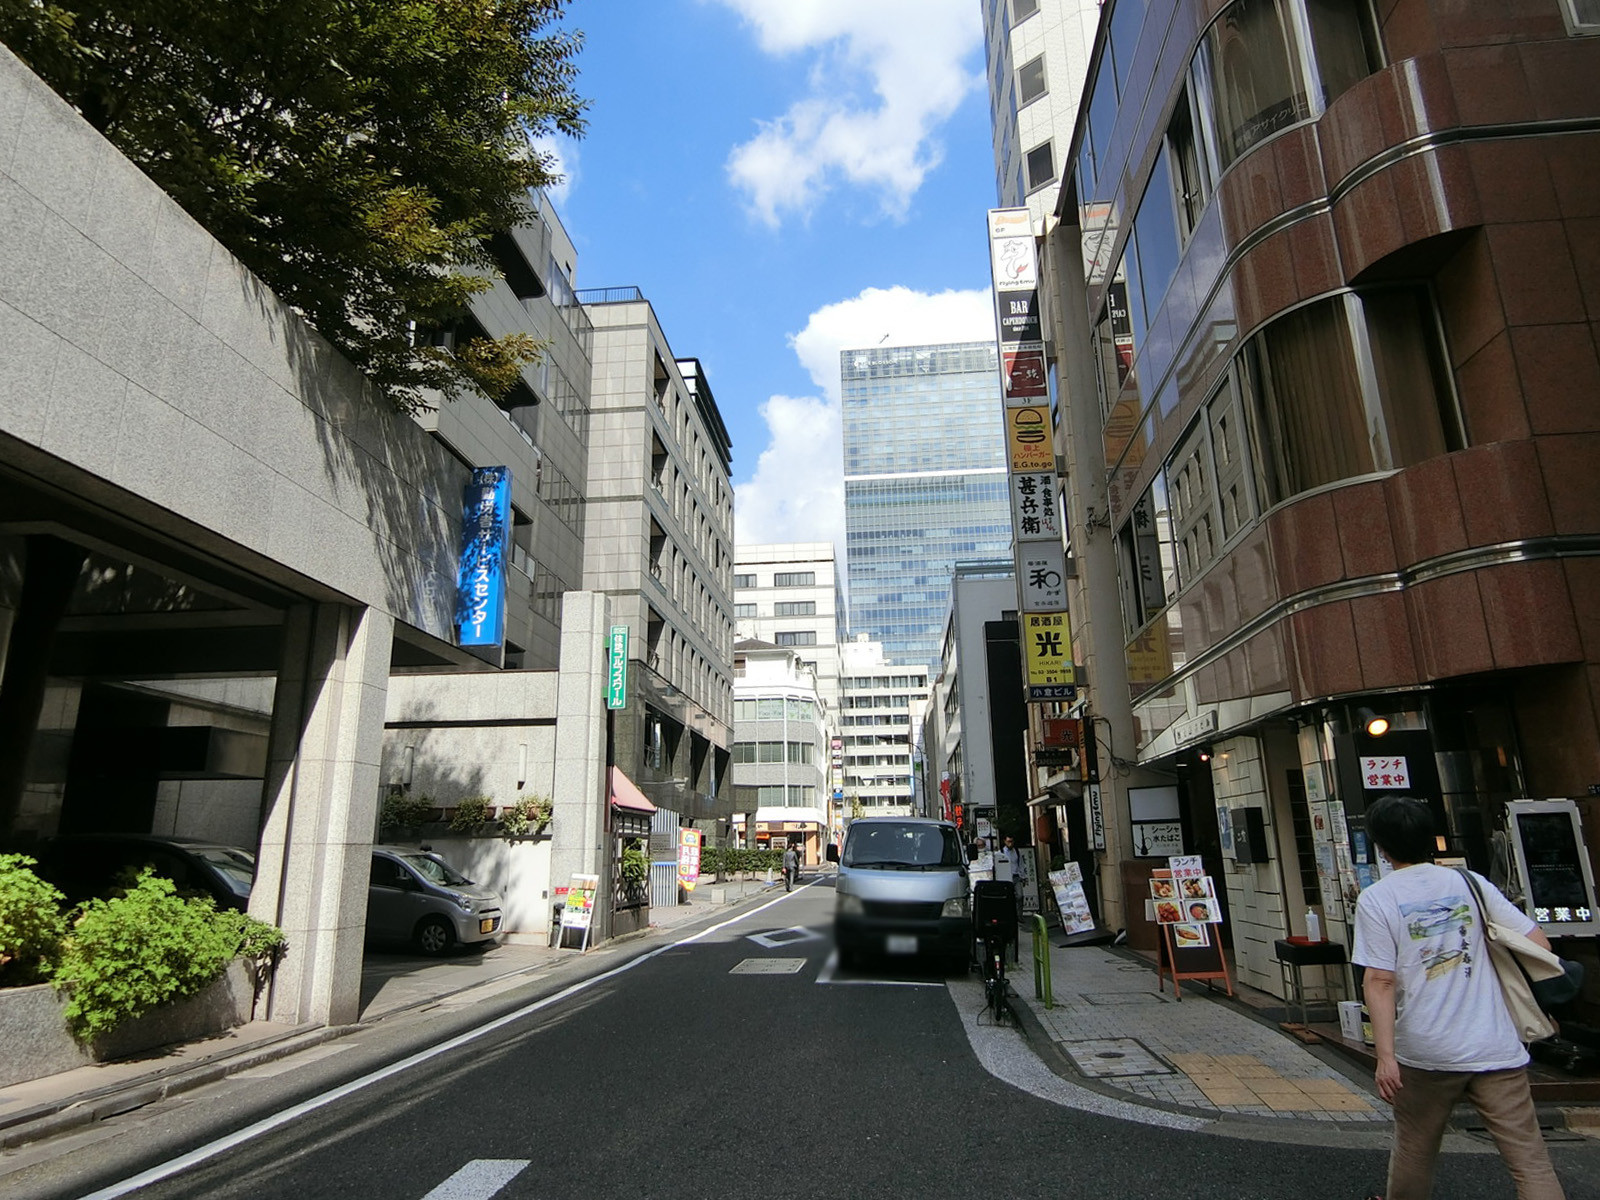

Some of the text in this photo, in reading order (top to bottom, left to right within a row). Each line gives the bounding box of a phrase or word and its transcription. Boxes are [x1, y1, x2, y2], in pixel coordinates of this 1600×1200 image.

[1009, 300, 1028, 314] BAR
[1017, 476, 1041, 535] 甚兵衛
[1029, 568, 1061, 589] 和
[1030, 616, 1063, 627] 居酒屋
[1035, 631, 1063, 657] 光
[1033, 688, 1072, 697] 小倉ビル
[1367, 758, 1402, 770] ランチ
[1367, 774, 1405, 786] 営業中
[1152, 825, 1180, 834] シーシャ
[1153, 834, 1181, 842] 水たばこ
[1173, 856, 1198, 867] ランチ
[1173, 868, 1202, 878] 営業中
[1534, 906, 1590, 922] 営業中
